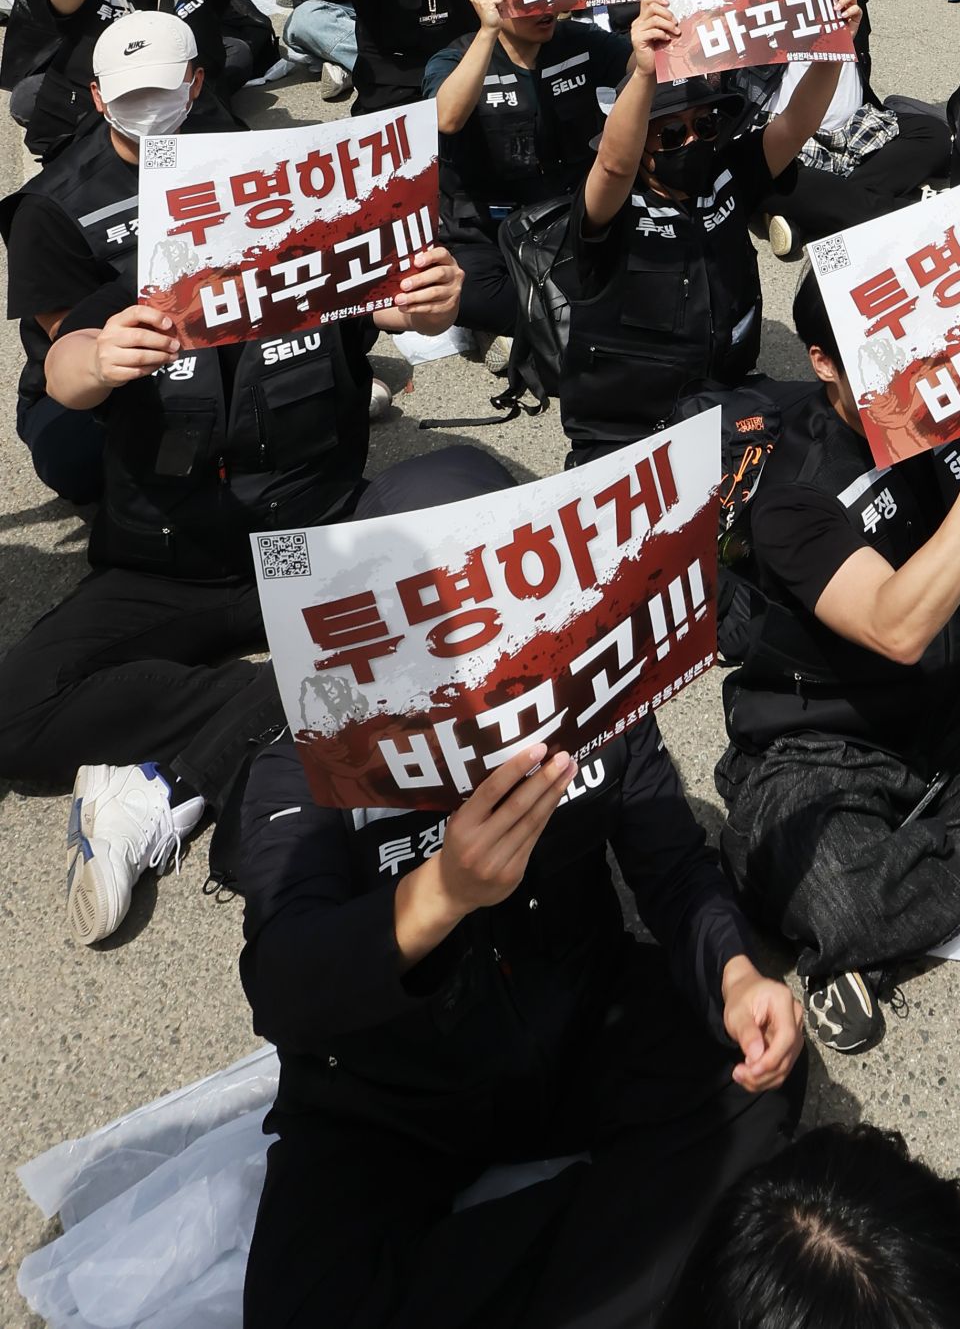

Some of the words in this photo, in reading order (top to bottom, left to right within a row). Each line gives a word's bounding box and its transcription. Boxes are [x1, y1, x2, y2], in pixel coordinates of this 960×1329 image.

[128, 40, 146, 50] NIKE
[486, 91, 518, 107] 투쟁
[552, 73, 586, 96] SELU
[166, 115, 412, 247] 투명하게
[636, 217, 677, 239] 투쟁
[704, 196, 736, 233] SELU
[199, 206, 434, 329] 바꾸고!!!
[319, 297, 394, 325] 삼성전자노동조합
[263, 332, 322, 366] SELU
[861, 487, 897, 534] 투쟁
[301, 439, 683, 685] 투명하게
[570, 700, 650, 764] 성전자노동조합
[650, 652, 715, 710] 공동투쟁본부
